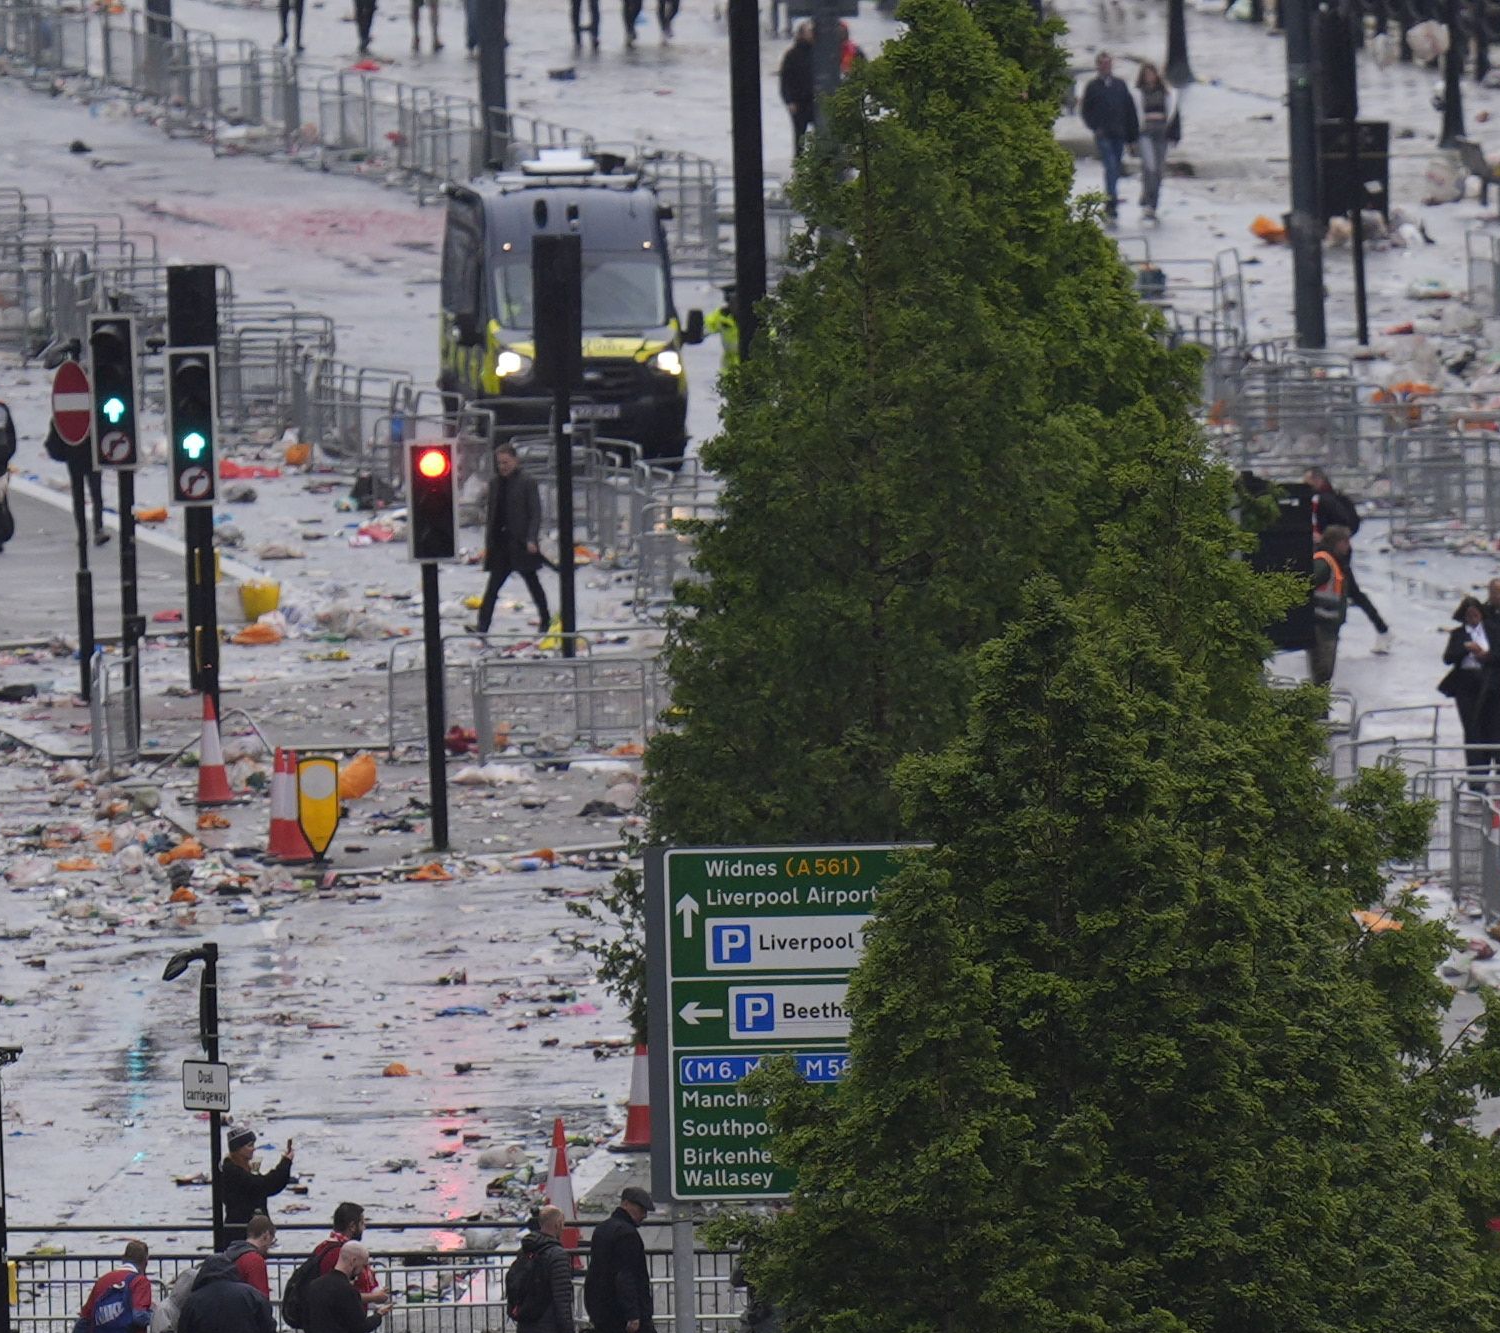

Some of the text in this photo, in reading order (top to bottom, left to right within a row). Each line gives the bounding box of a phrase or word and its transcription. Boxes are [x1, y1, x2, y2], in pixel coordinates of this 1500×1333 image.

[705, 860, 778, 877] Widnes
[707, 887, 878, 908] Liverpool Airport
[760, 934, 855, 953] Liverpool
[783, 1003, 852, 1020] Beetha
[198, 1070, 214, 1084] Dual
[187, 1089, 227, 1105] carriageway
[683, 1119, 772, 1139] Southpo
[683, 1147, 773, 1165] Birkenhe
[683, 1170, 774, 1189] Wallasey
